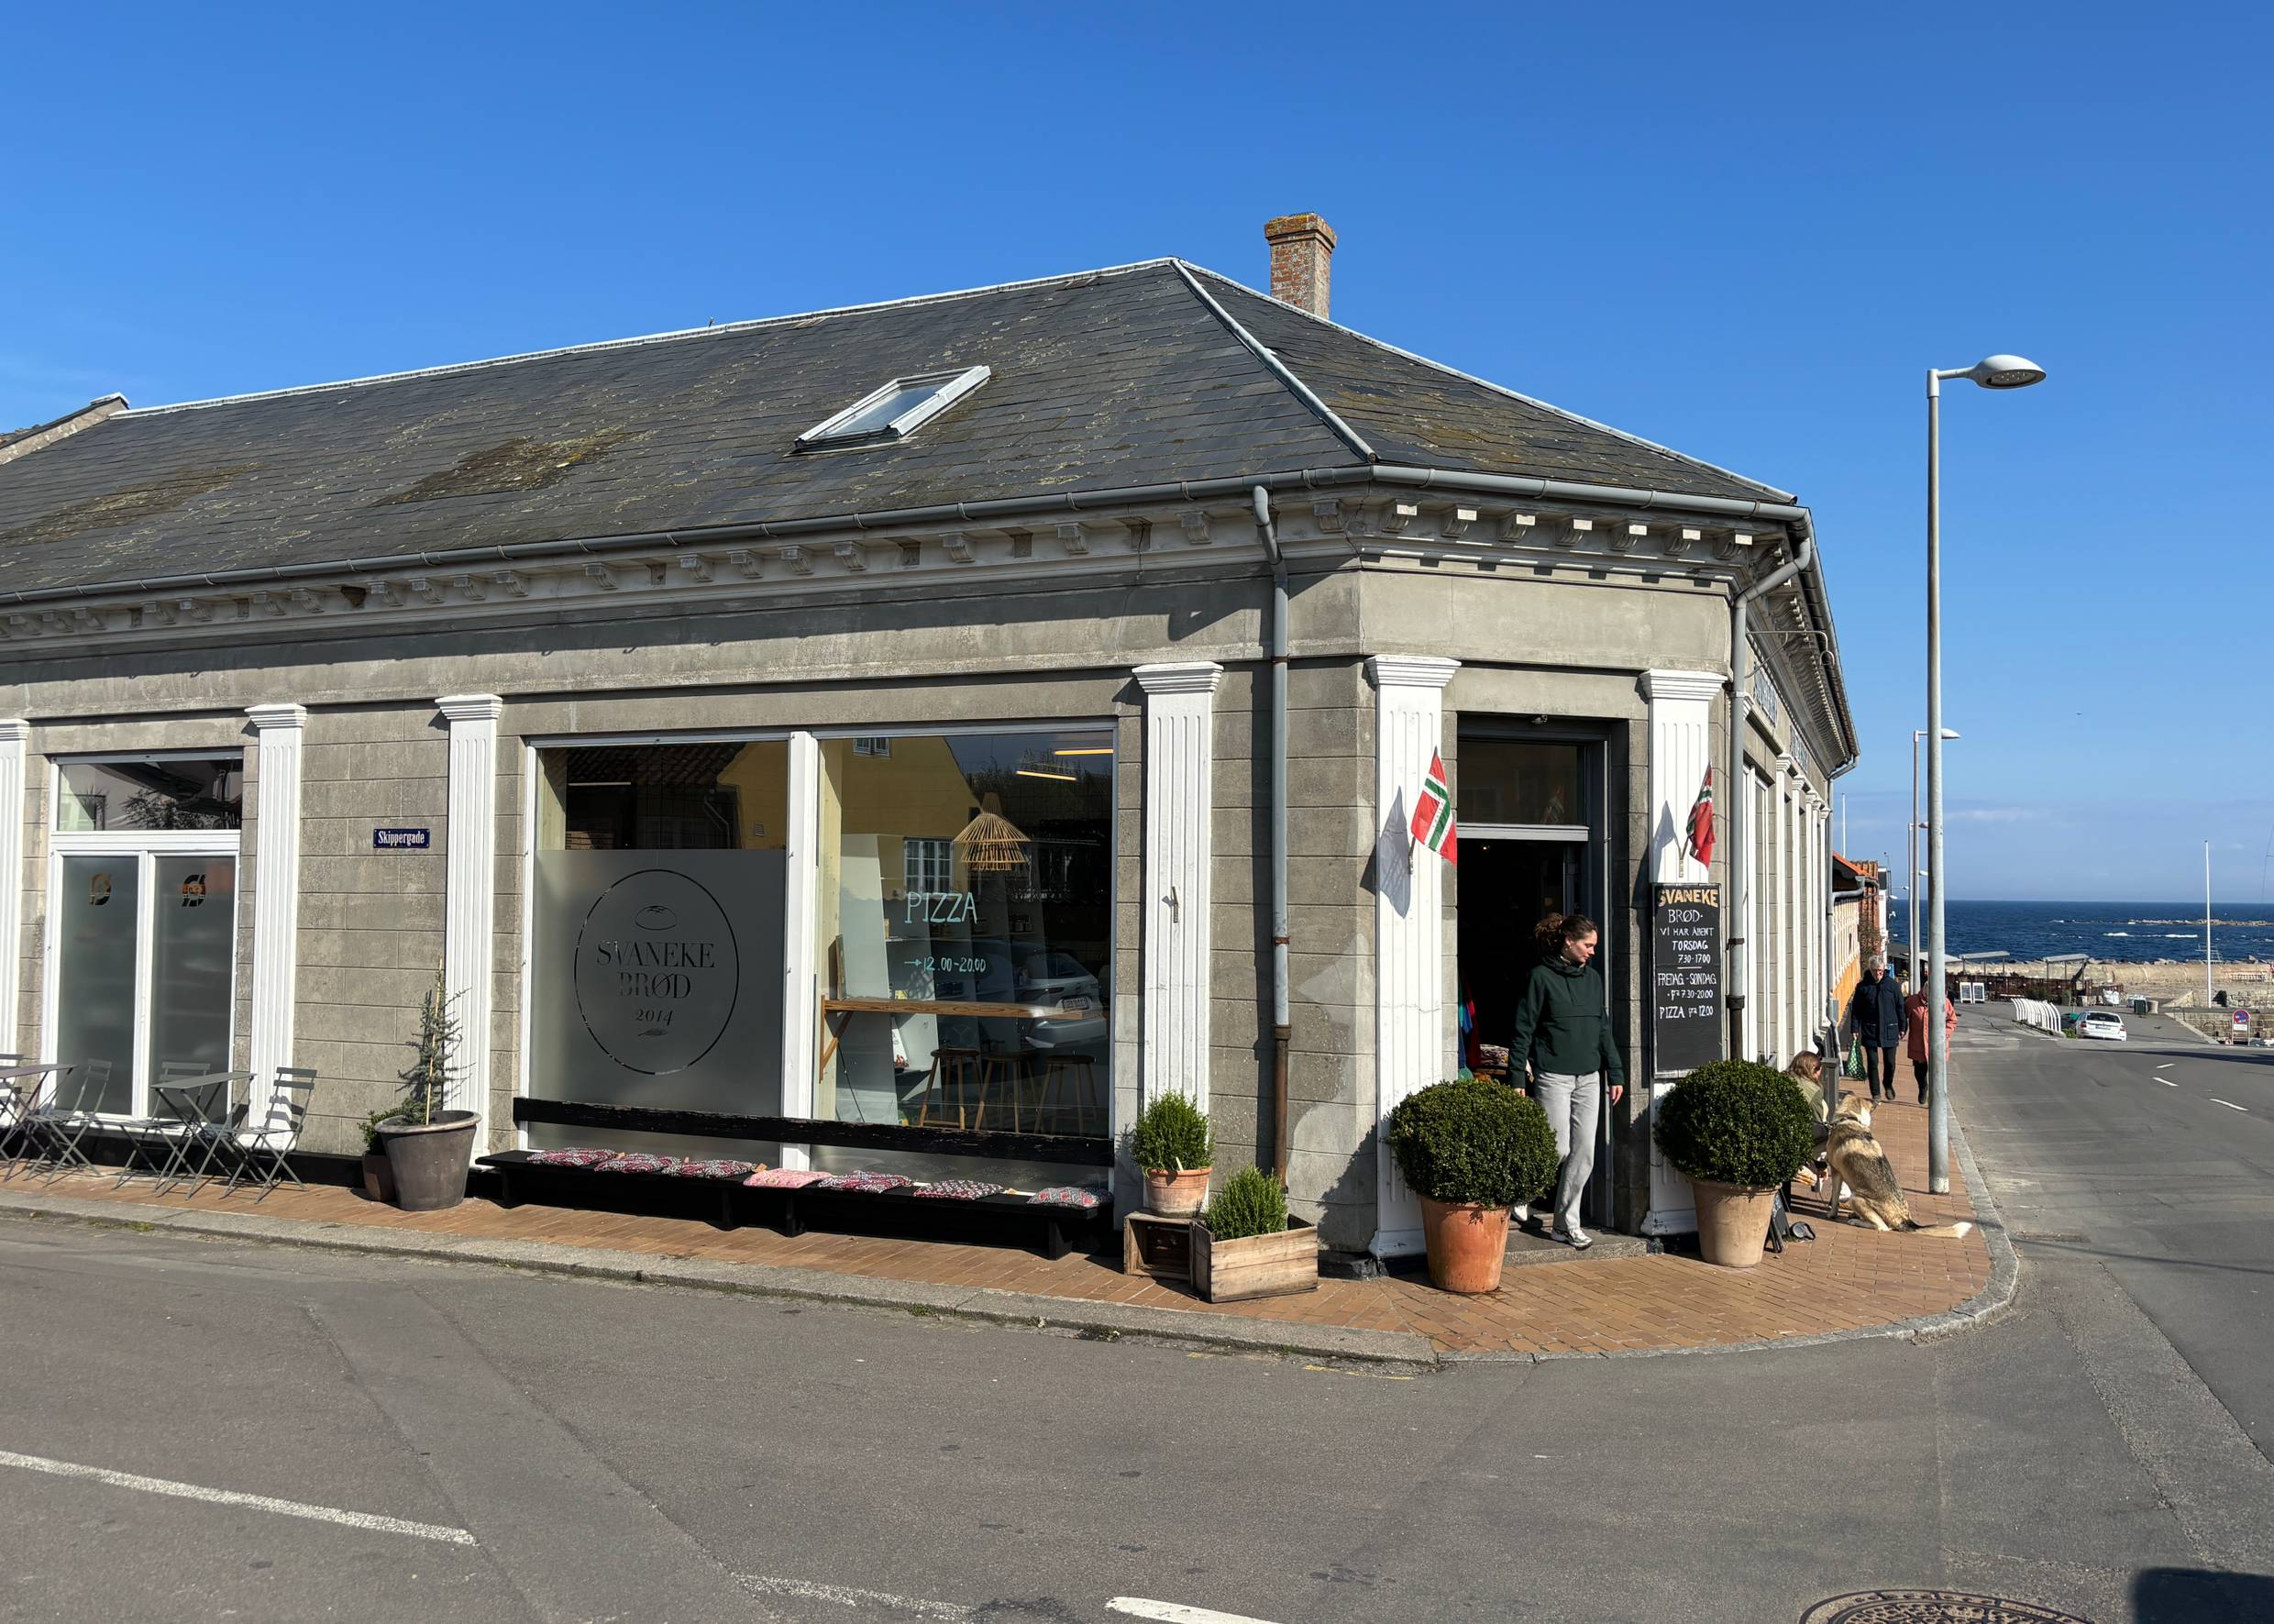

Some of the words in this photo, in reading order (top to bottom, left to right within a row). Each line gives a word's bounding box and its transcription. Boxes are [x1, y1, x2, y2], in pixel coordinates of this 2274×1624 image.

[378, 830, 425, 846] Skippergade
[1658, 889, 1718, 908] SVANEKE
[904, 891, 977, 924] PIZZA
[1660, 926, 1670, 936] VI
[1672, 927, 1690, 936] HAR
[1672, 940, 1708, 951] TORSDAG
[596, 940, 715, 968] SVANEKE
[618, 972, 691, 999] BRØD
[1658, 973, 1684, 986] FREDAG
[635, 1009, 674, 1026] 2014
[1660, 1005, 1685, 1020] PIZZA
